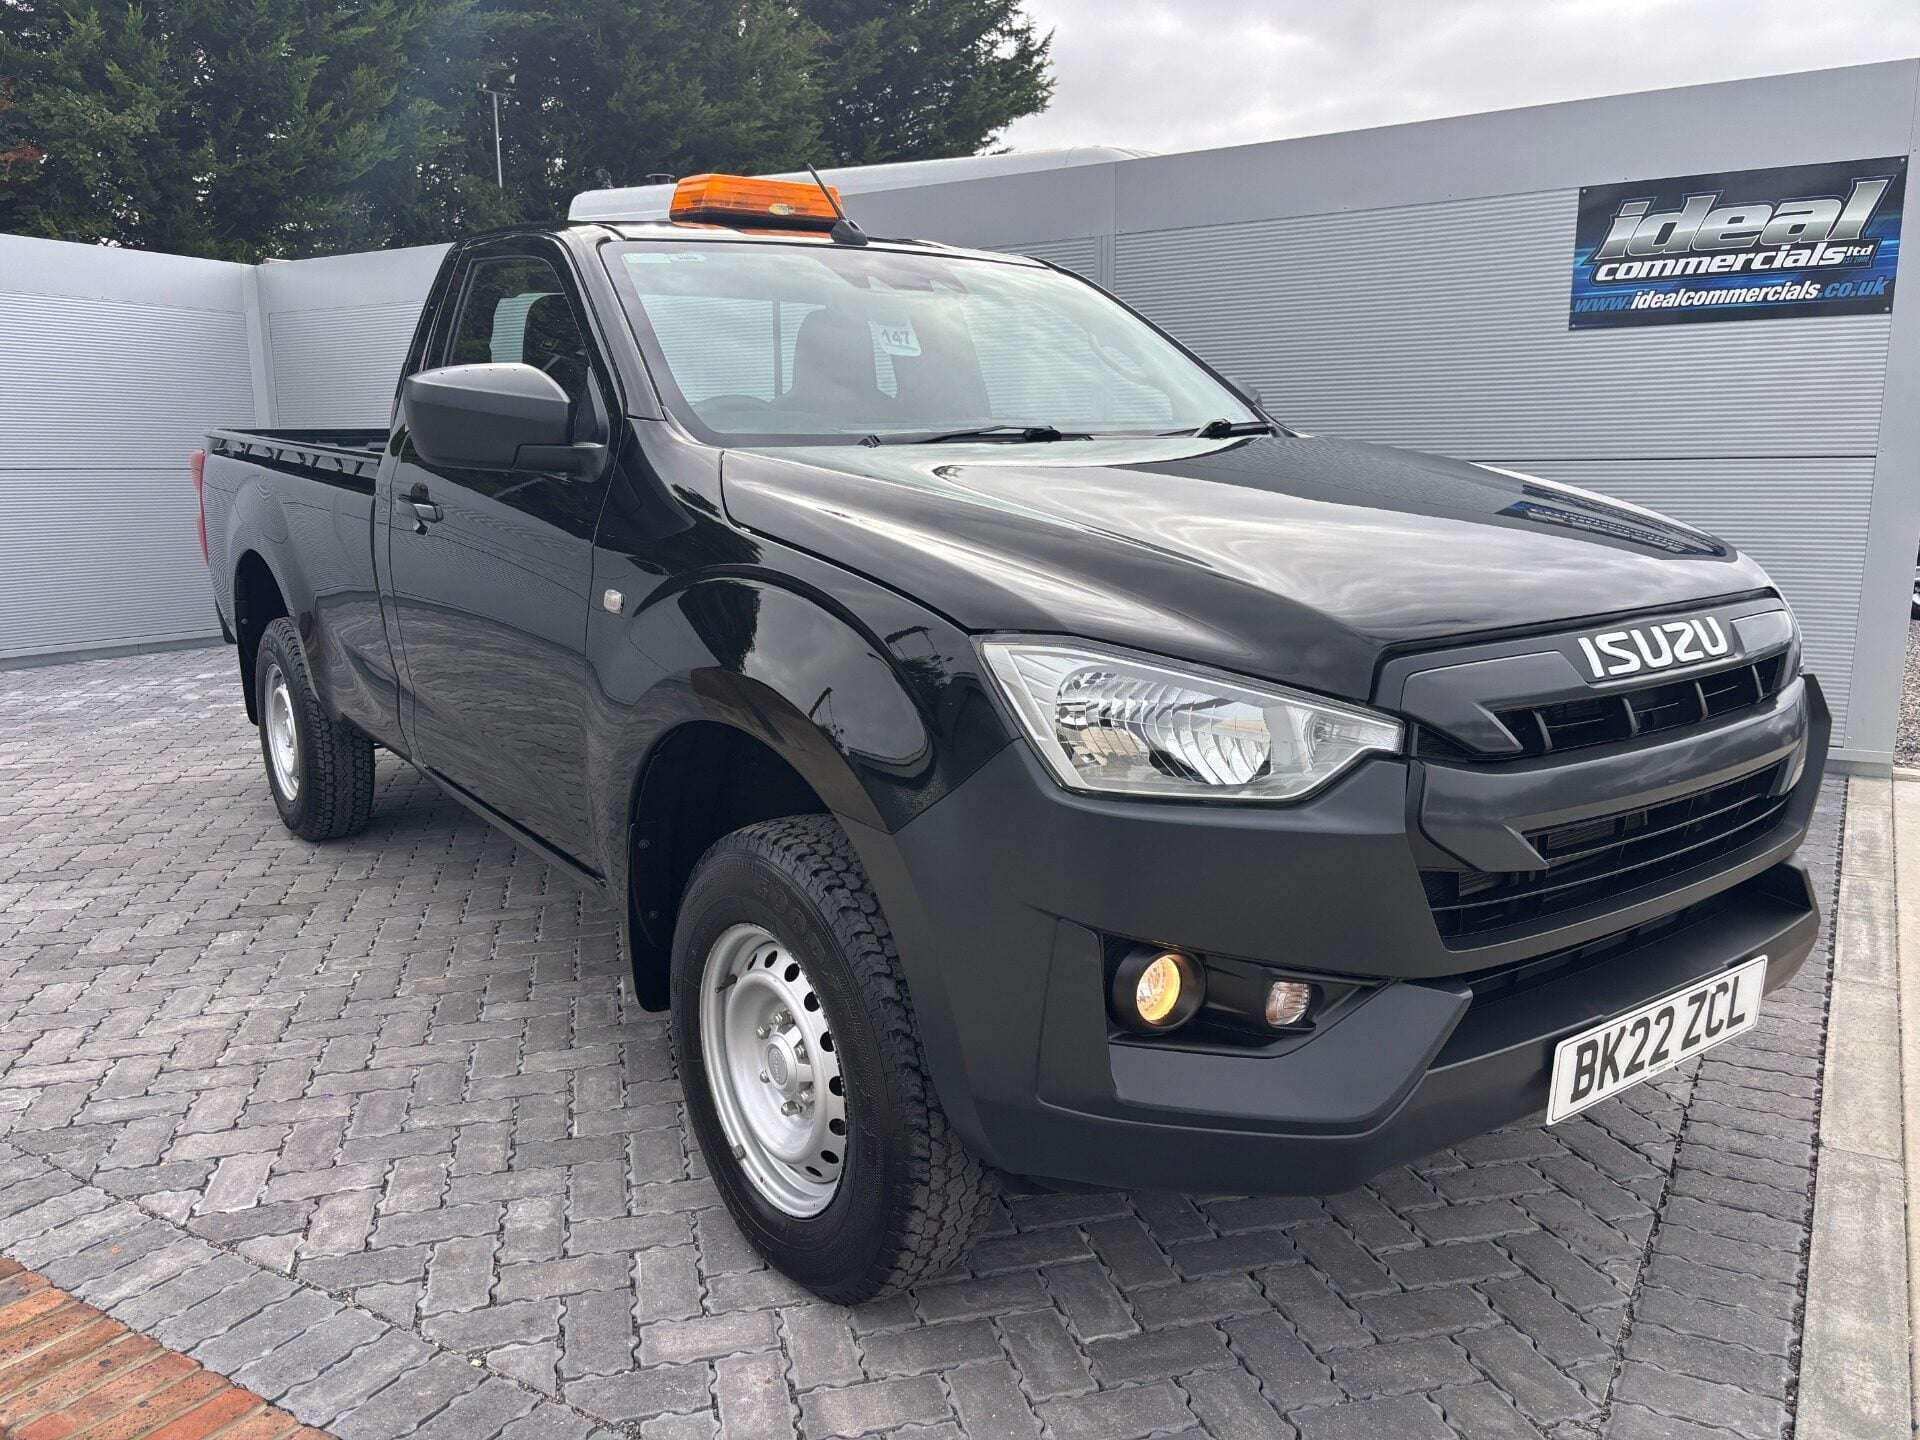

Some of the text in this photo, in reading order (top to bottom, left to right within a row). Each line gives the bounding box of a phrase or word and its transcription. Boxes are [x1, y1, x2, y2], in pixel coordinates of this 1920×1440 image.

[1596, 178, 1889, 260] ideal
[1596, 242, 1874, 282] commercials ltd
[1574, 276, 1889, 312] www.idealcommercials.co.uk
[1578, 616, 1728, 678] ISUZU
[1570, 975, 1746, 1104] BK22 ZCL
